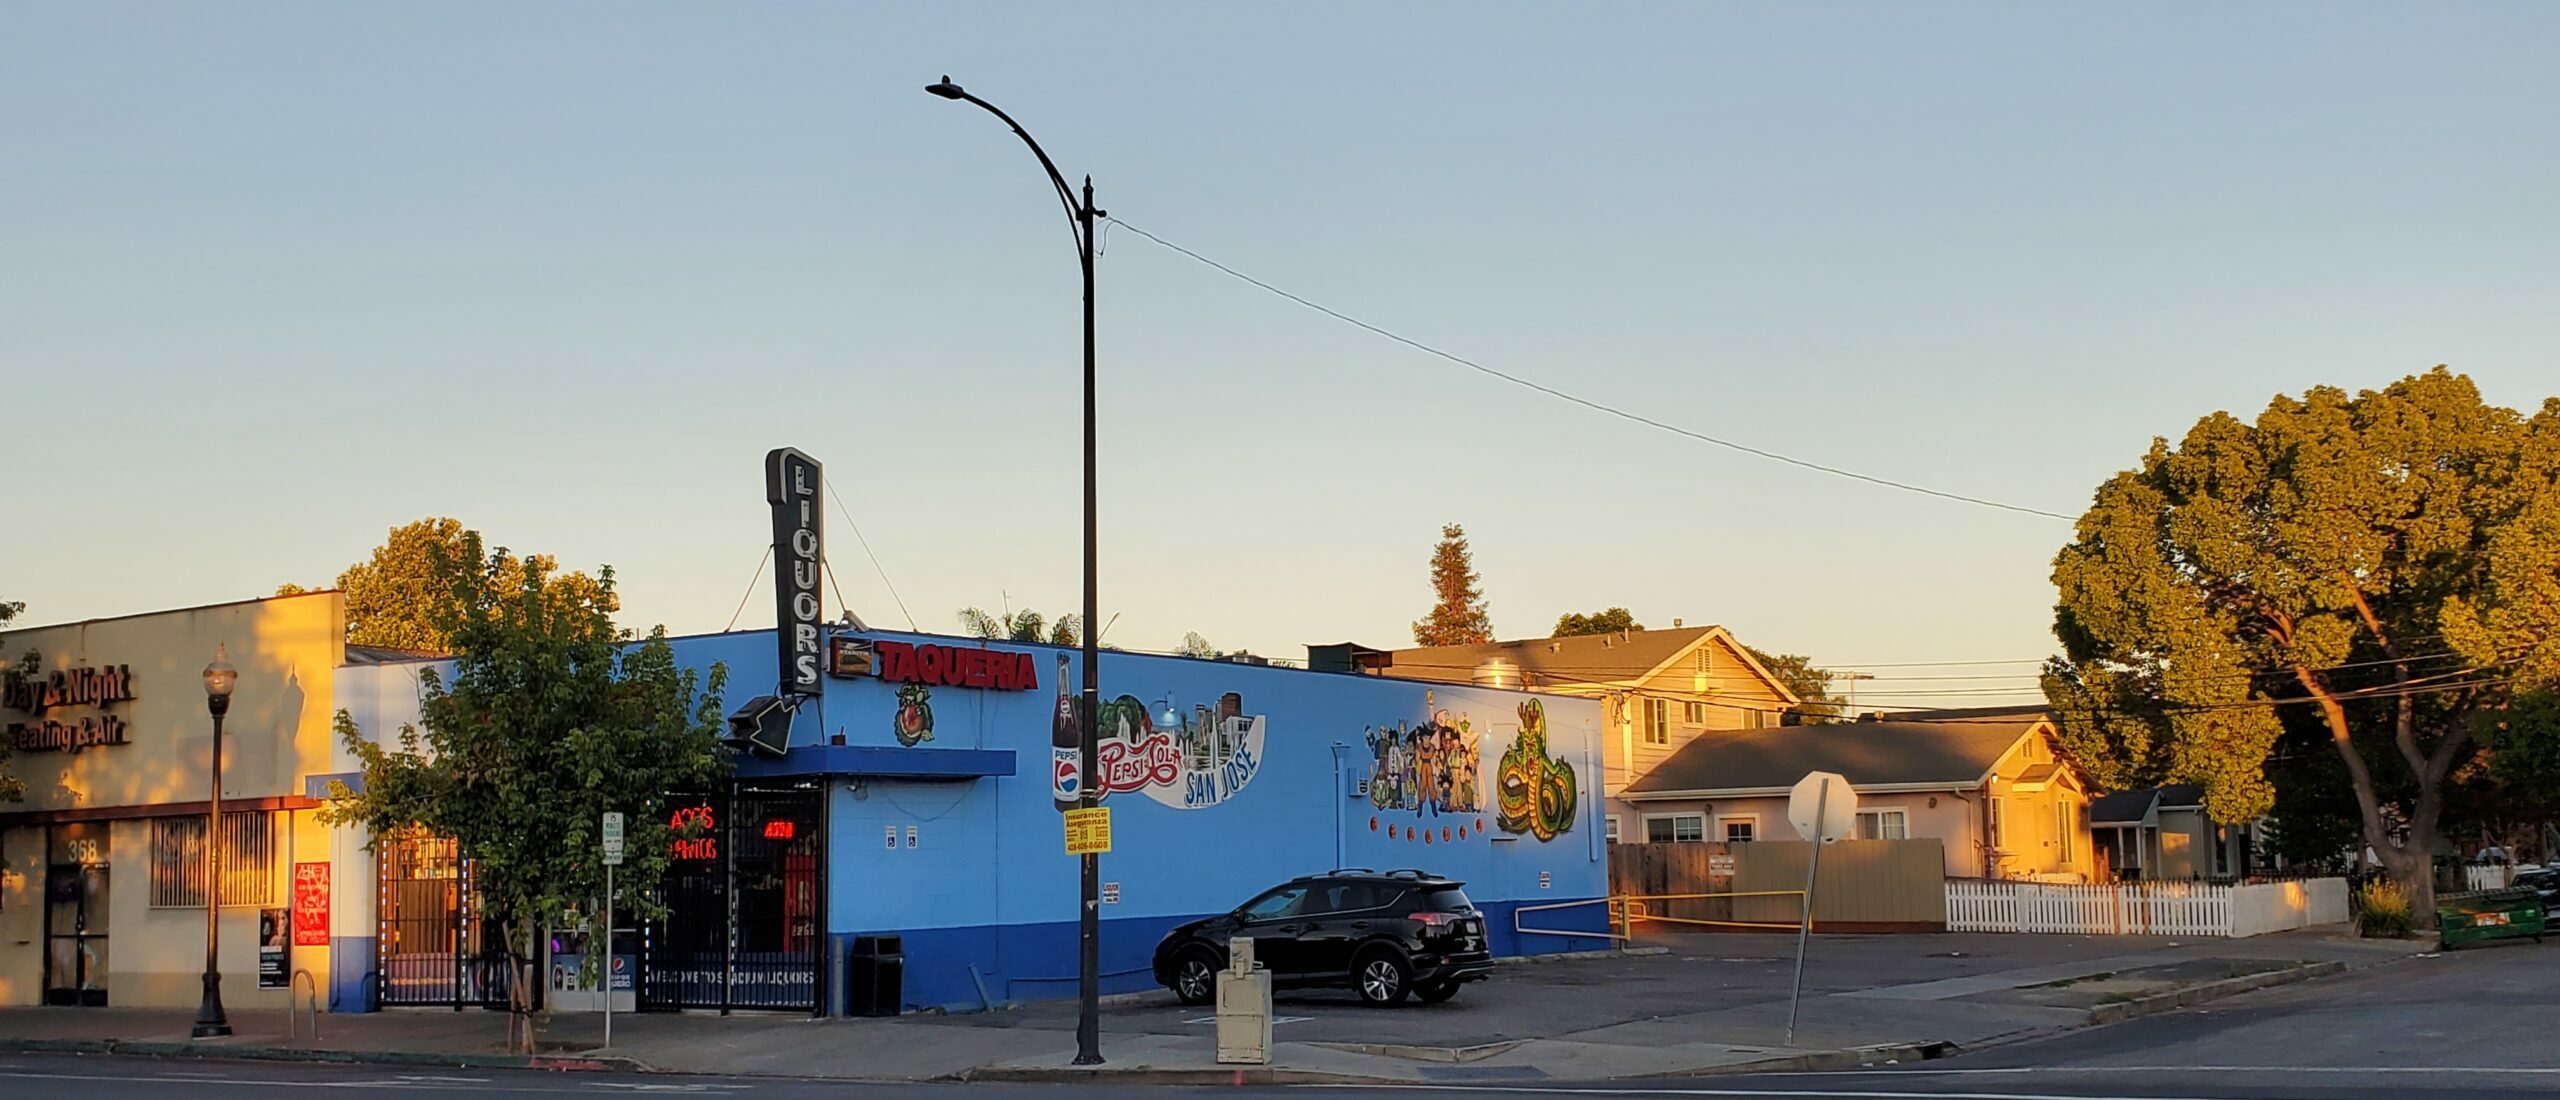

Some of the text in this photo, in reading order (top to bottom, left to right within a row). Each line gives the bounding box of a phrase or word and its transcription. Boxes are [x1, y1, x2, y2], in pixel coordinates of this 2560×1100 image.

[793, 465, 819, 686] LIQUORS
[877, 641, 1038, 690] TAQUERIA
[5, 665, 129, 714] Day & Night
[77, 717, 92, 745] &
[94, 716, 121, 744] Air
[1055, 750, 1078, 760] PEPSI
[1185, 772, 1216, 805] SAN
[68, 839, 97, 862] 368
